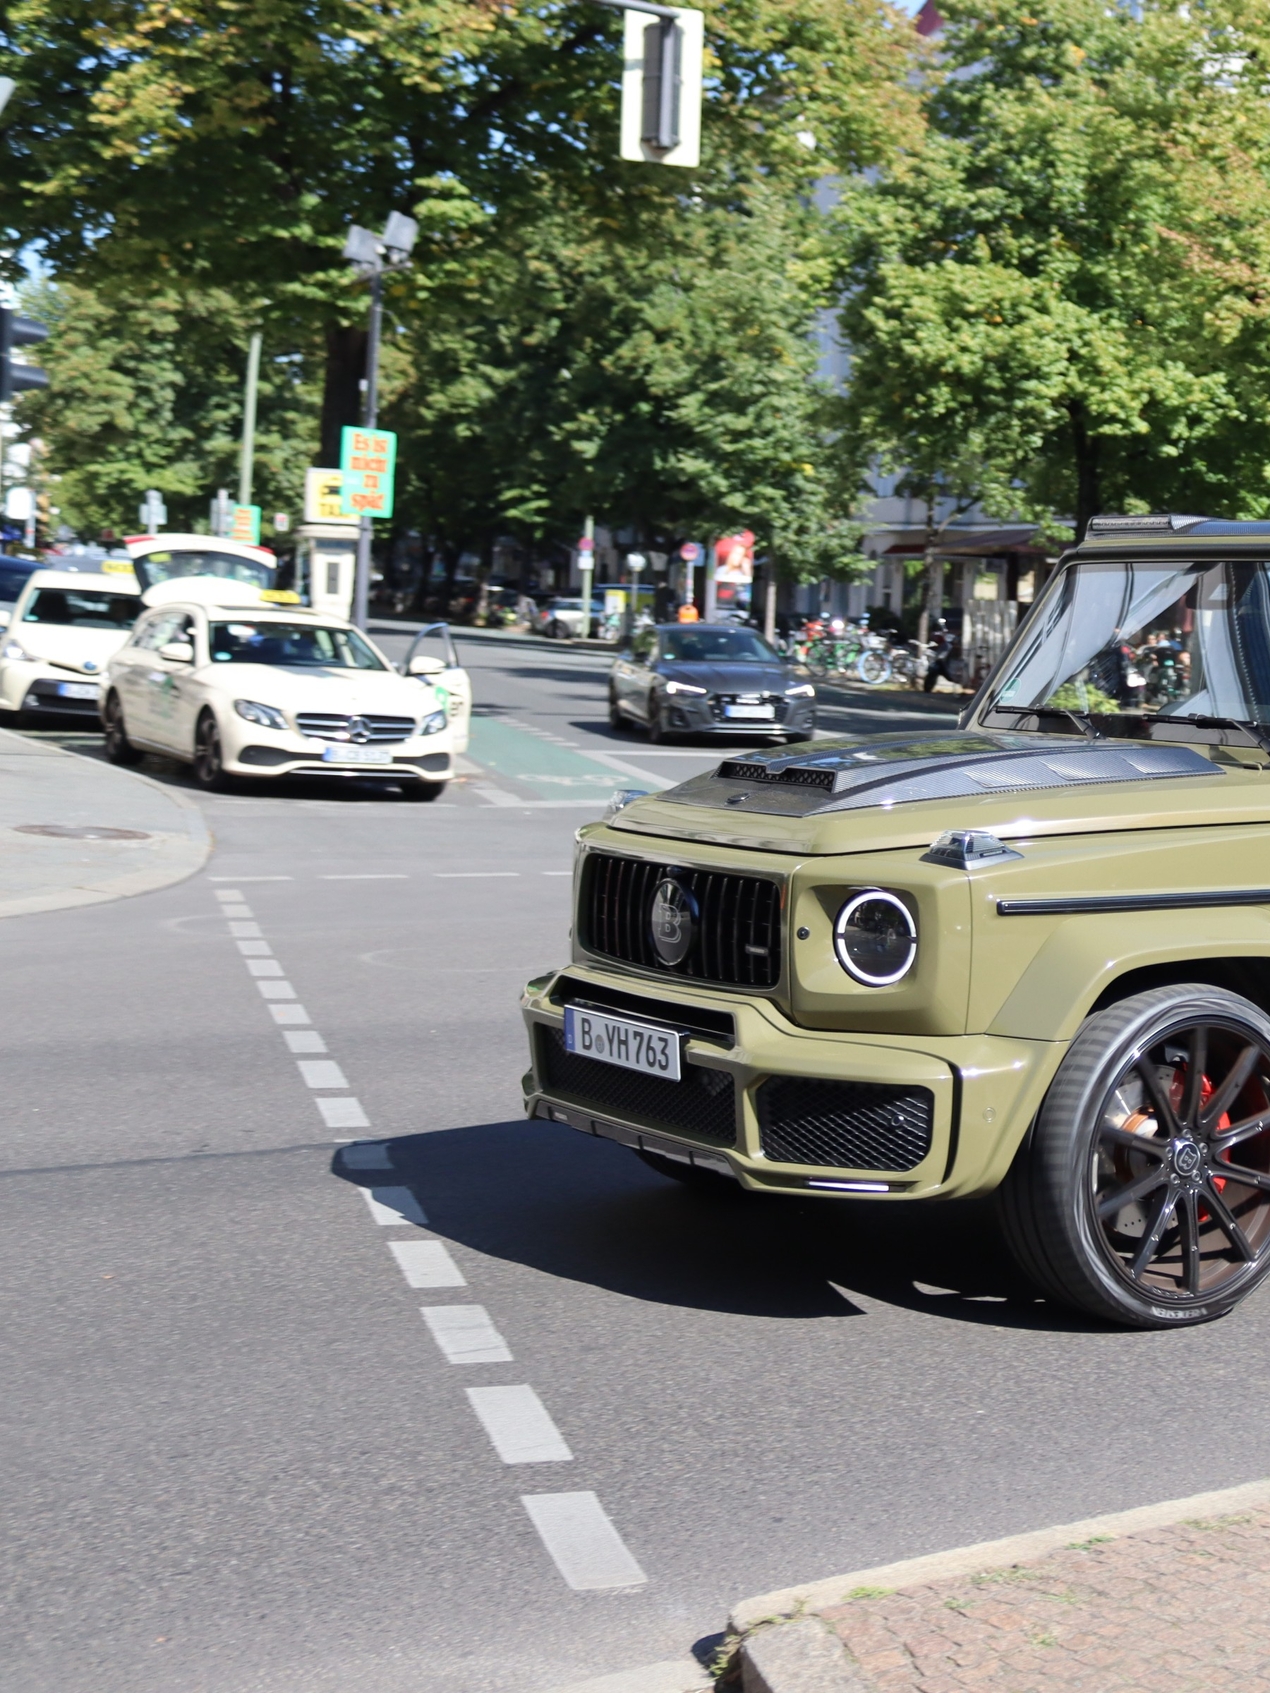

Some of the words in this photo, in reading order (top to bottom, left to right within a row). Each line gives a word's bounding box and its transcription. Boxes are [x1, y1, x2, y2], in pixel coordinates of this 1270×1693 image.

[354, 432, 369, 451] Es
[373, 434, 388, 453] ist
[351, 453, 386, 473] nicht
[364, 473, 379, 489] zu
[351, 490, 385, 512] spät
[581, 1017, 593, 1051] B
